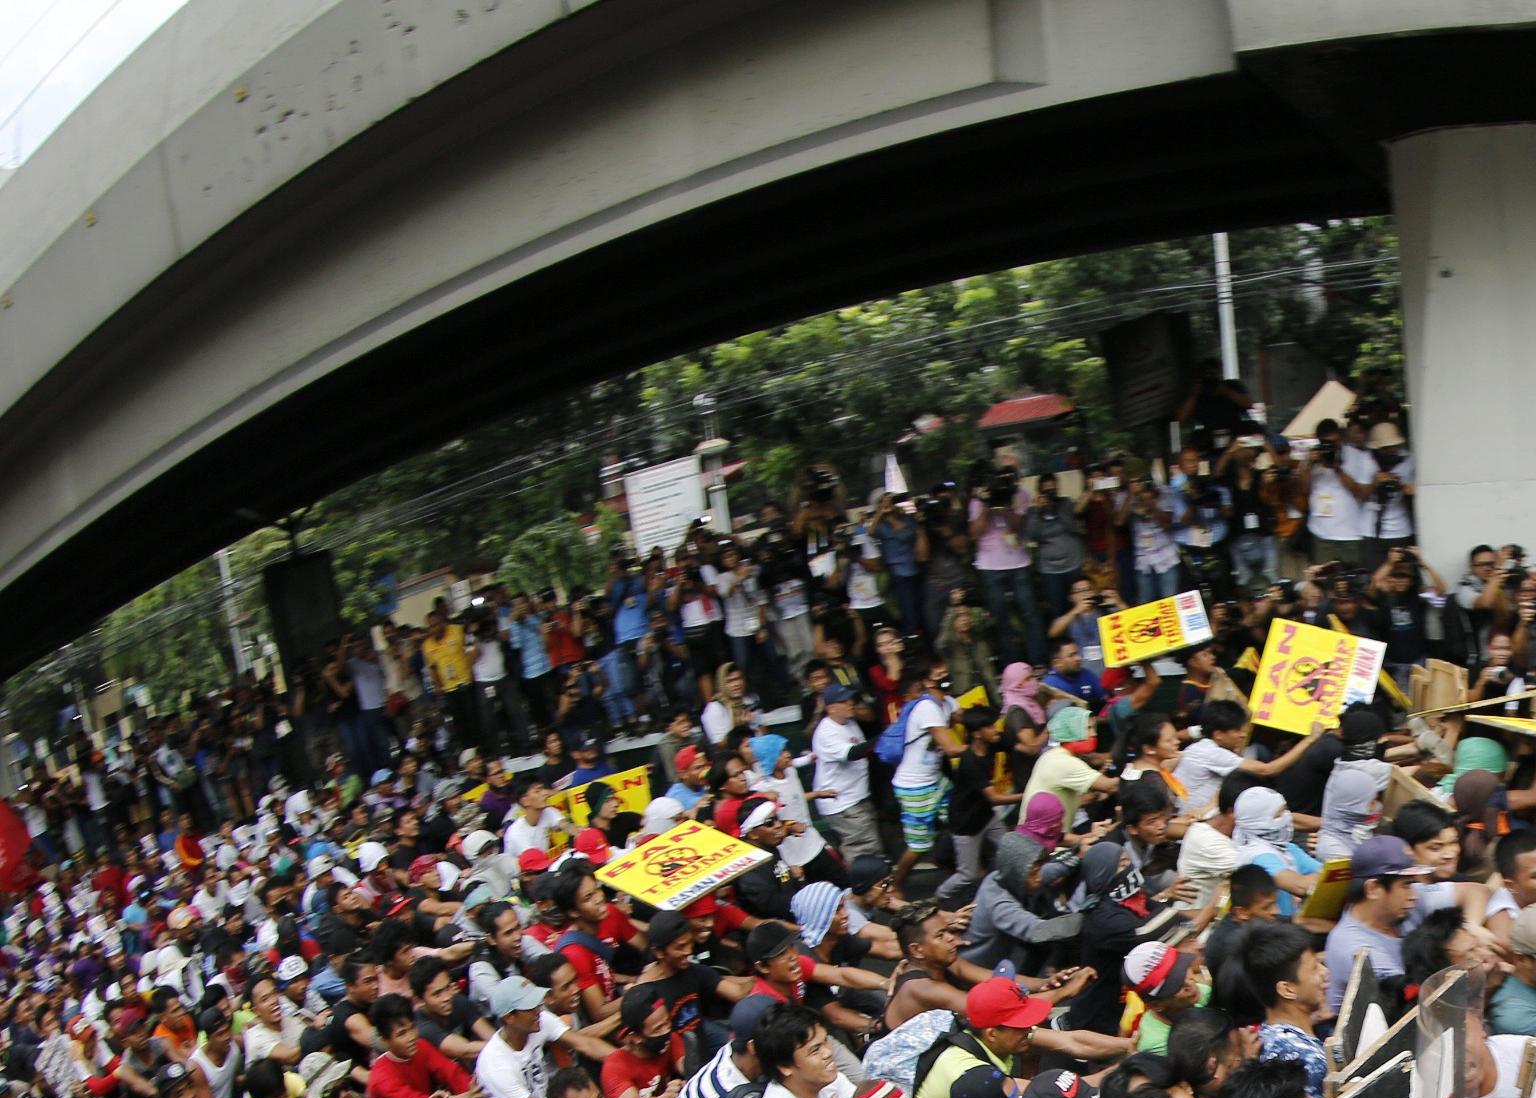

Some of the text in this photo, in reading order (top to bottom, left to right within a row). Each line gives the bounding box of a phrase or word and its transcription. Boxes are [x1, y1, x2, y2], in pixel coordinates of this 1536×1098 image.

[1256, 623, 1298, 721] BAN
[605, 825, 703, 879] BAN
[642, 842, 738, 895] TRUMP
